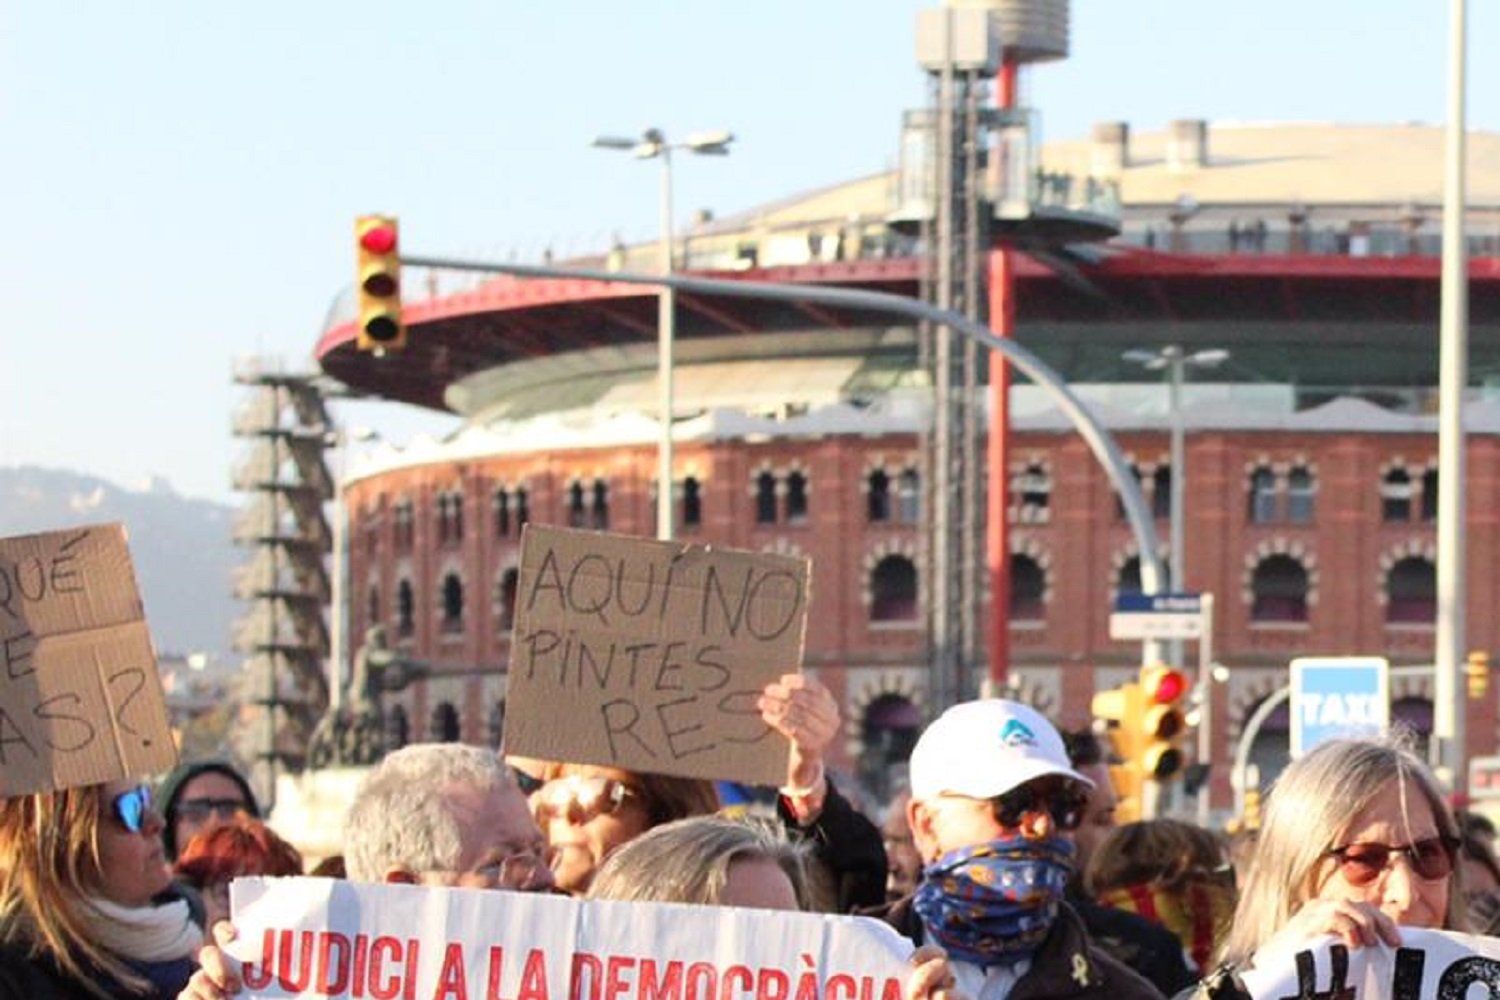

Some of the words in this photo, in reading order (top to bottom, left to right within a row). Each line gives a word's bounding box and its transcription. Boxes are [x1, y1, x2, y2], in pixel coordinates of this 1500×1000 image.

[527, 548, 685, 626] AQUÍ
[702, 564, 802, 641] NO
[525, 630, 732, 692] PINTES
[602, 690, 774, 760] RES
[1300, 692, 1381, 727] TAXI
